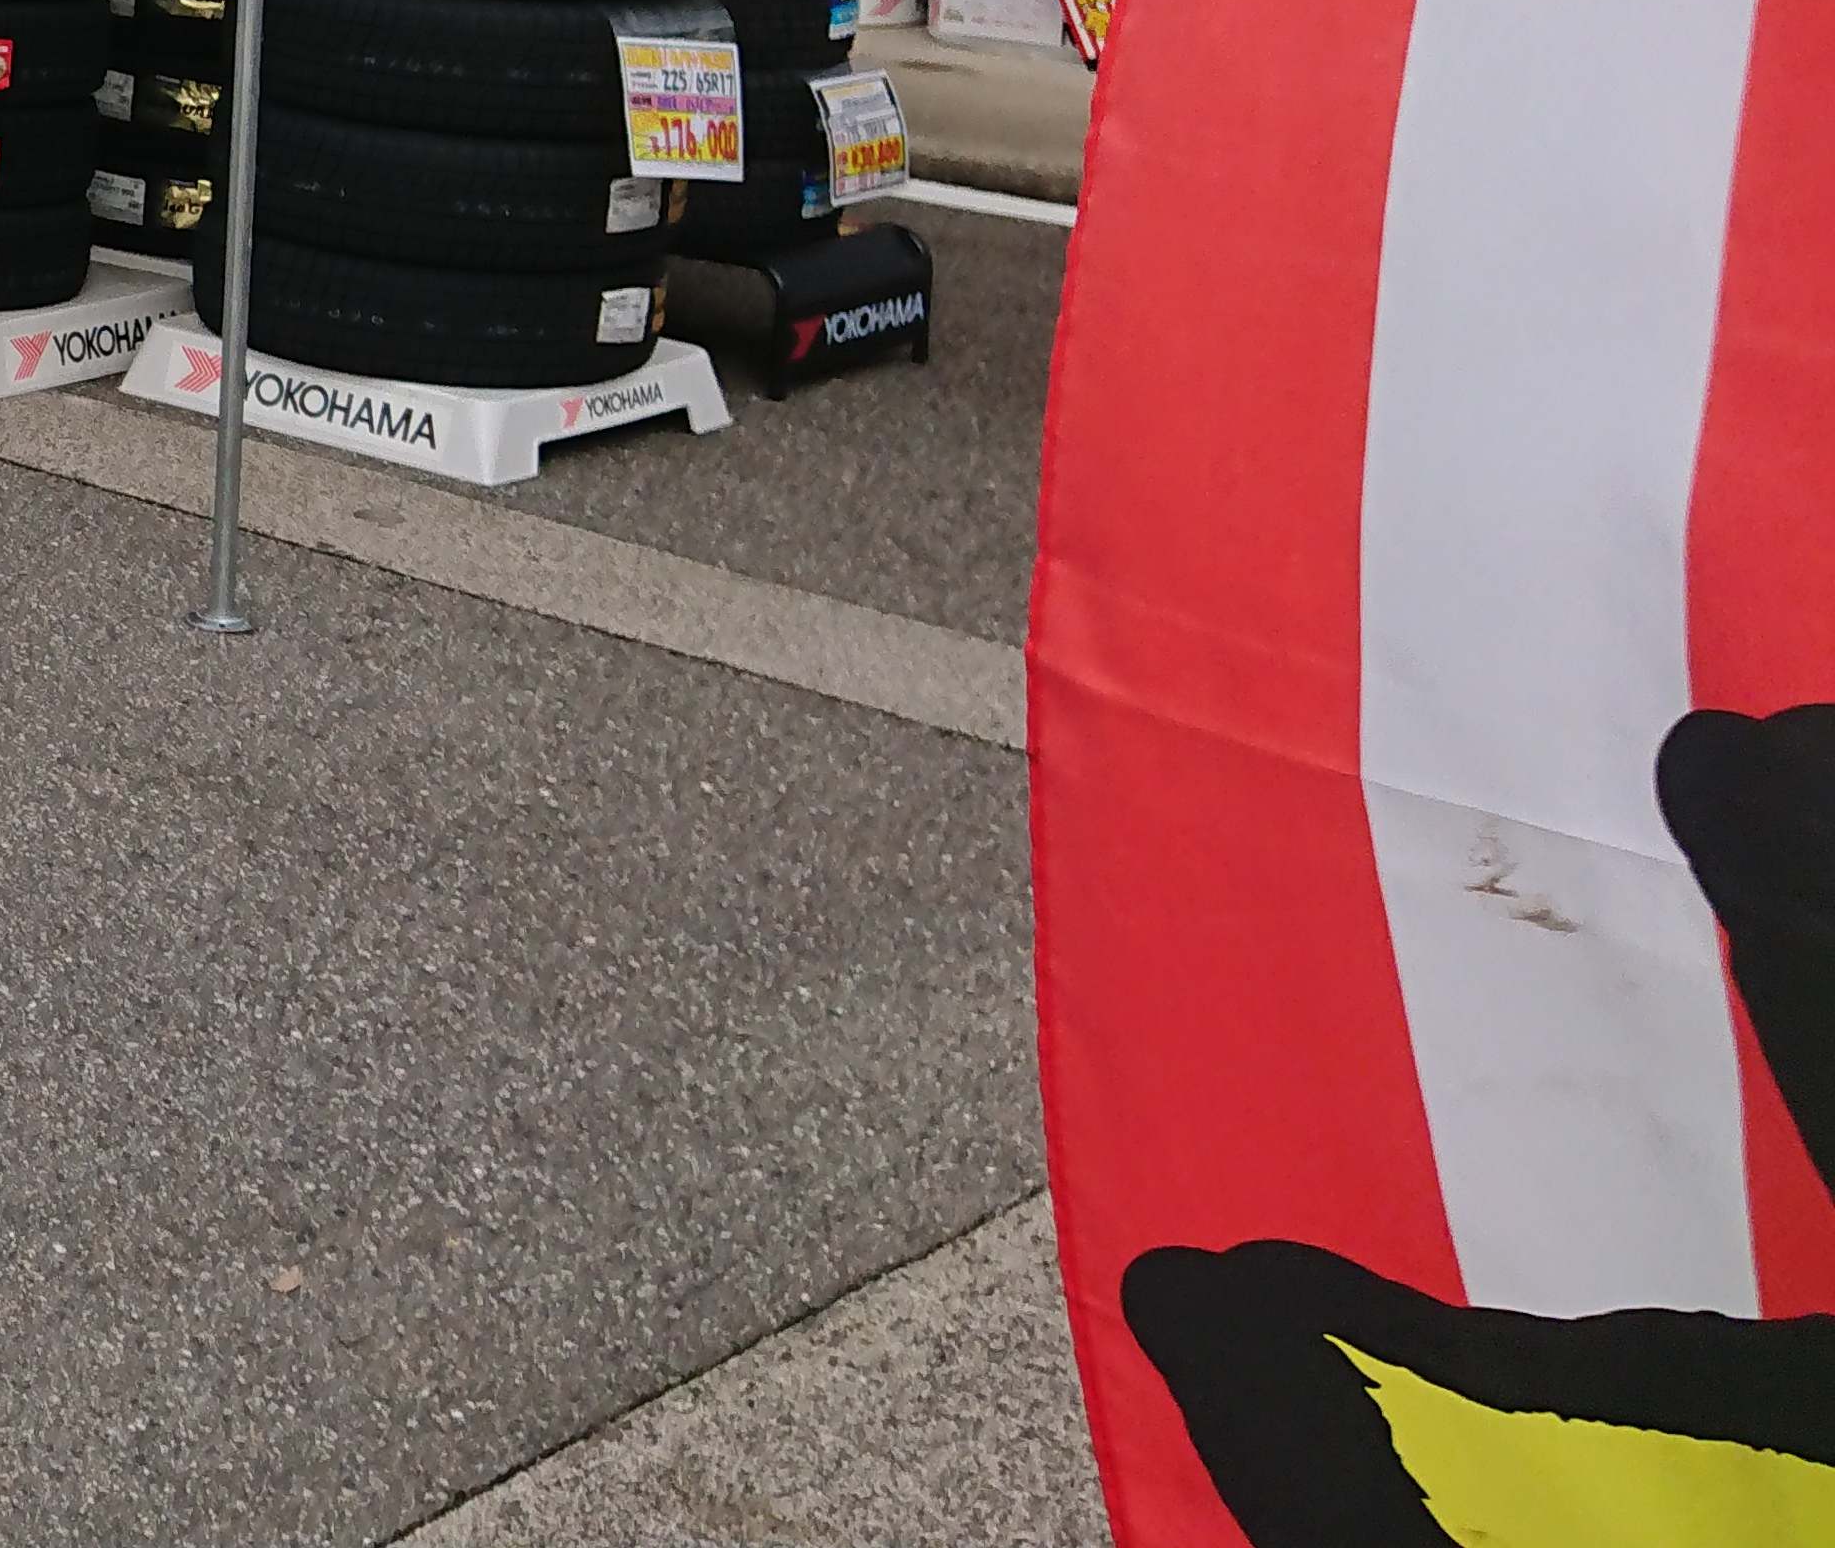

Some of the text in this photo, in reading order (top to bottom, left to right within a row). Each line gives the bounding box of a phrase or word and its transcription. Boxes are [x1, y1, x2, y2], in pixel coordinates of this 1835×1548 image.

[649, 116, 738, 161] ¥176,000
[52, 307, 181, 365] YOKOHA
[822, 291, 927, 347] YOKOHAMA
[242, 368, 437, 451] YOKOHAMA
[585, 381, 665, 420] YOKOHAMA
